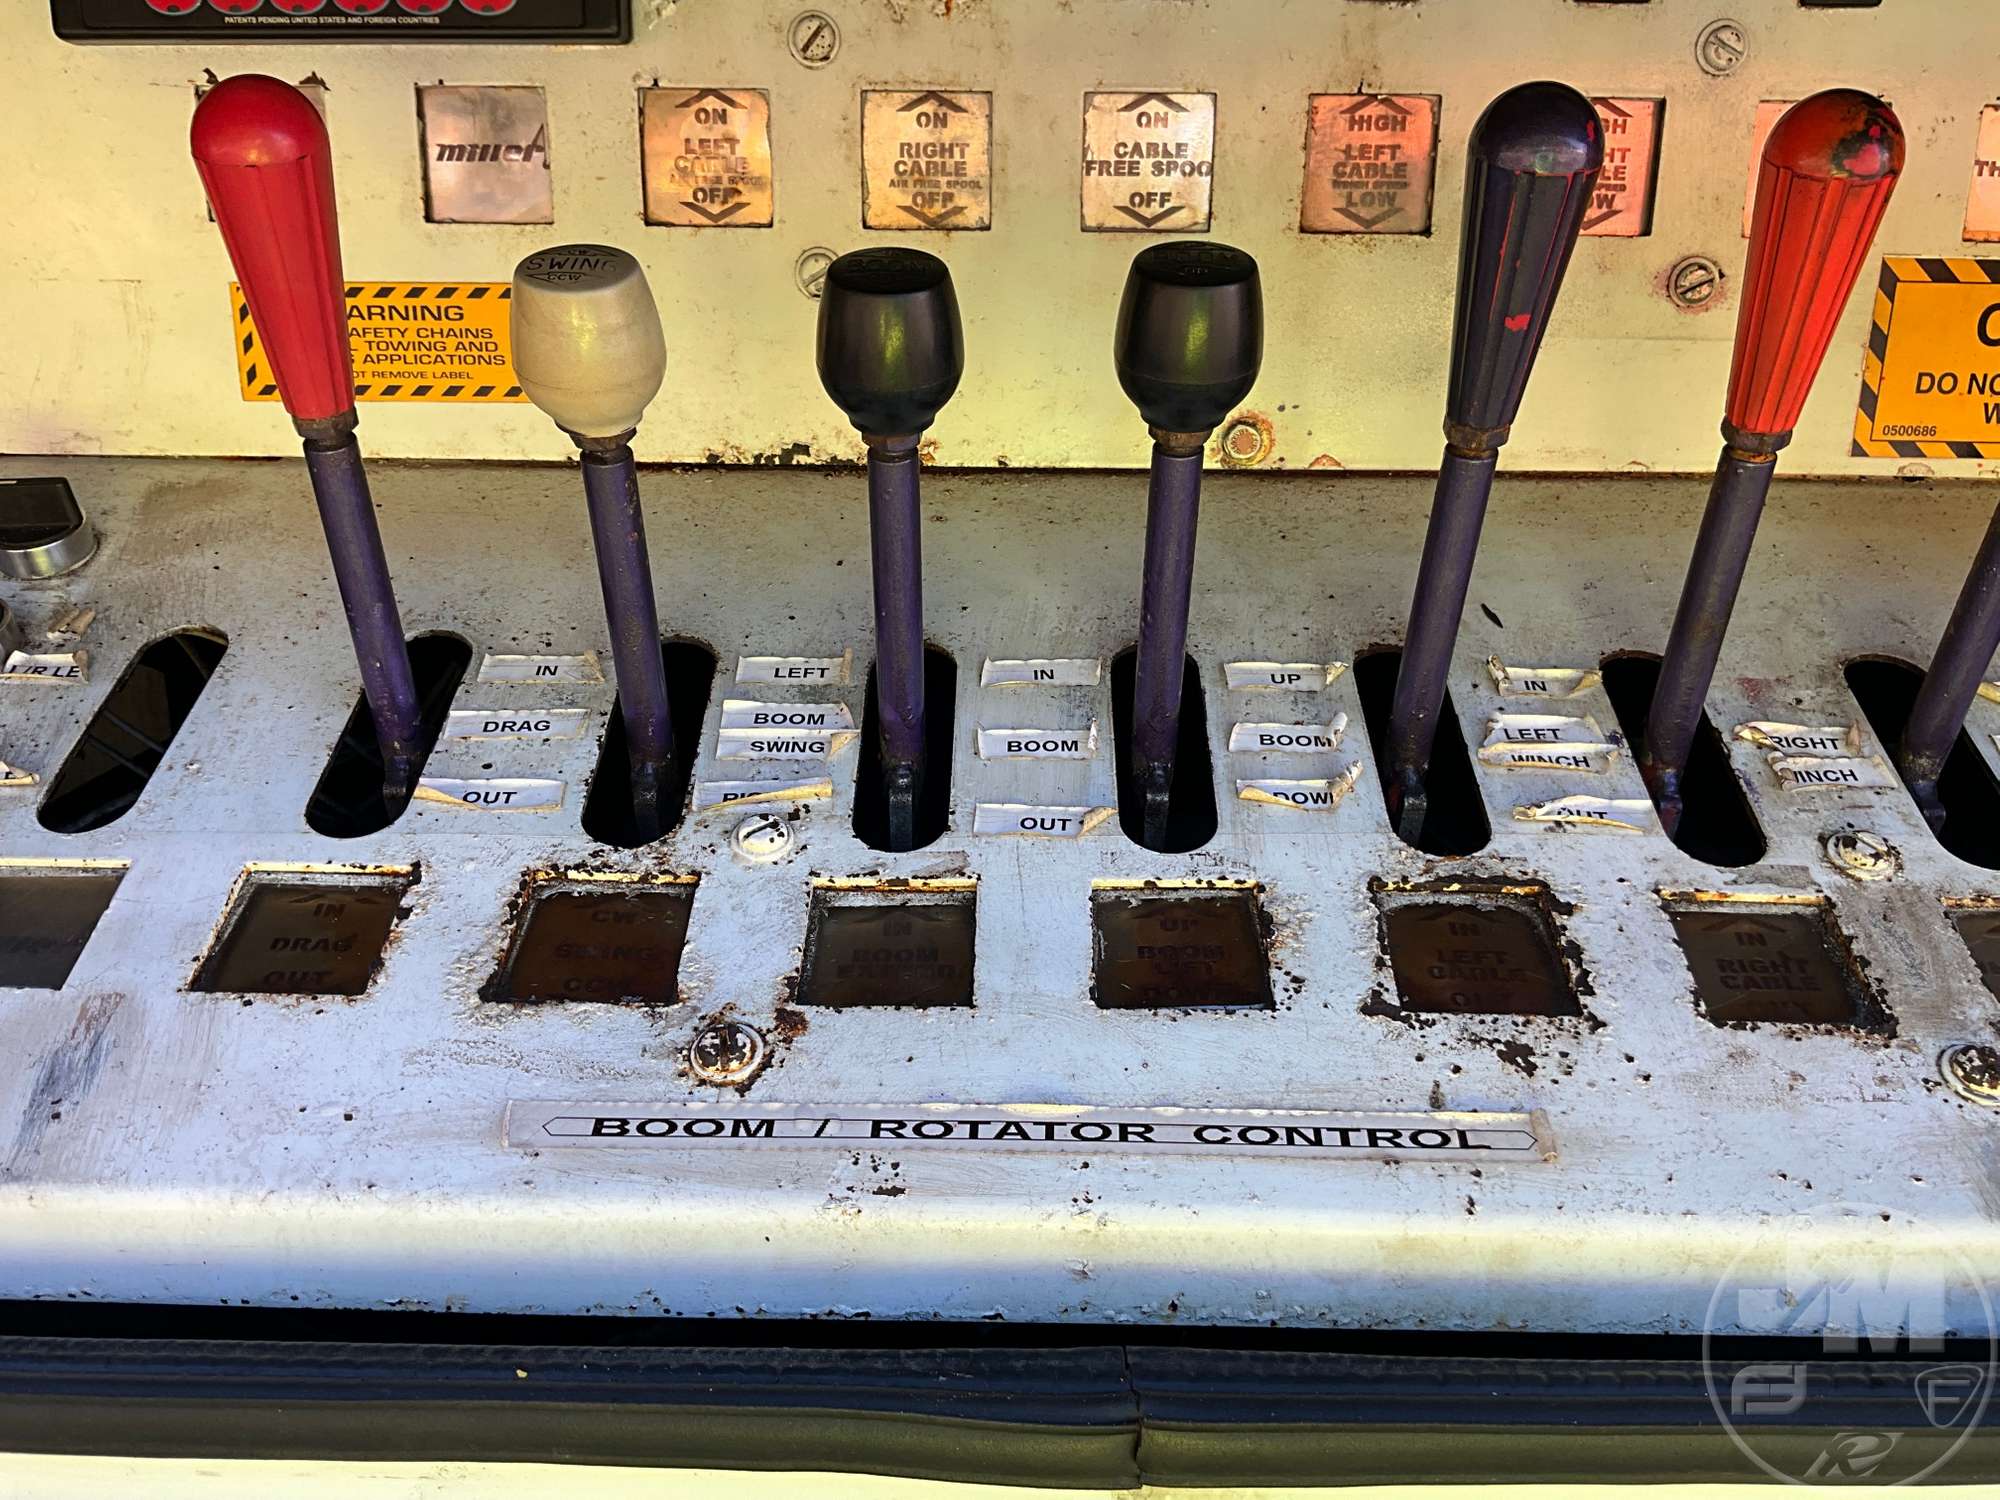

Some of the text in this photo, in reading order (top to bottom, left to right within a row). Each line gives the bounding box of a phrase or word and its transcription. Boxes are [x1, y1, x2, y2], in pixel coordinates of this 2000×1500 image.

[224, 16, 257, 24] PATENTS
[257, 16, 290, 24] PENDING
[290, 16, 318, 24] UNITED
[318, 16, 346, 24] STATES
[347, 16, 363, 24] AND
[363, 16, 396, 24] FOREIGN
[694, 107, 728, 125] ON
[915, 111, 948, 129] ON
[1136, 111, 1169, 129] ON
[1348, 114, 1407, 132] HIGH
[684, 137, 741, 155] LEFT
[899, 142, 970, 159] RIGHT
[1113, 142, 1189, 159] CABLE
[1344, 143, 1402, 161] LEFT
[894, 160, 968, 178] CABLE
[1084, 160, 1141, 176] FREE
[1332, 161, 1408, 179] CABLE
[888, 178, 983, 189] AIR FREE SPOOL
[692, 187, 743, 204] OFF
[911, 191, 955, 209] OFF
[1128, 192, 1173, 209] OFF
[1345, 191, 1397, 208] LOW
[526, 257, 617, 272] SWING
[348, 305, 465, 321] ARNING
[350, 327, 493, 339] AFETY CHAINS
[365, 340, 447, 352] TOWING
[454, 341, 499, 352] AND
[362, 354, 506, 366] APPLICATIONS
[352, 371, 367, 379] OT
[372, 371, 428, 379] REMOVE
[1915, 371, 1959, 395] DO
[1882, 425, 1937, 437] 0500686
[535, 665, 559, 676] IN
[773, 667, 831, 679] LEFT
[1033, 669, 1055, 680] IN
[1270, 673, 1302, 684] UP
[1524, 680, 1547, 692] IN
[482, 720, 551, 732] DRAG
[753, 713, 826, 725] BOOM
[1259, 734, 1332, 748] BOOM
[1503, 728, 1561, 740] LEFT
[750, 741, 825, 754] SWING
[1006, 740, 1079, 752] BOOM
[1766, 735, 1840, 750] RIGHT
[1511, 754, 1591, 768] WINCH
[462, 791, 518, 804] OUT
[1272, 791, 1334, 805] DOW
[1020, 817, 1072, 832] OUT
[312, 903, 348, 917] IN
[269, 937, 355, 951] DRAG
[1734, 932, 1768, 947] IN
[1714, 958, 1810, 974] RIGHT
[1719, 975, 1823, 991] CABLE
[591, 1118, 776, 1138] BOOM
[870, 1119, 1156, 1142] ROTATOR
[1192, 1125, 1492, 1150] CONTROL
